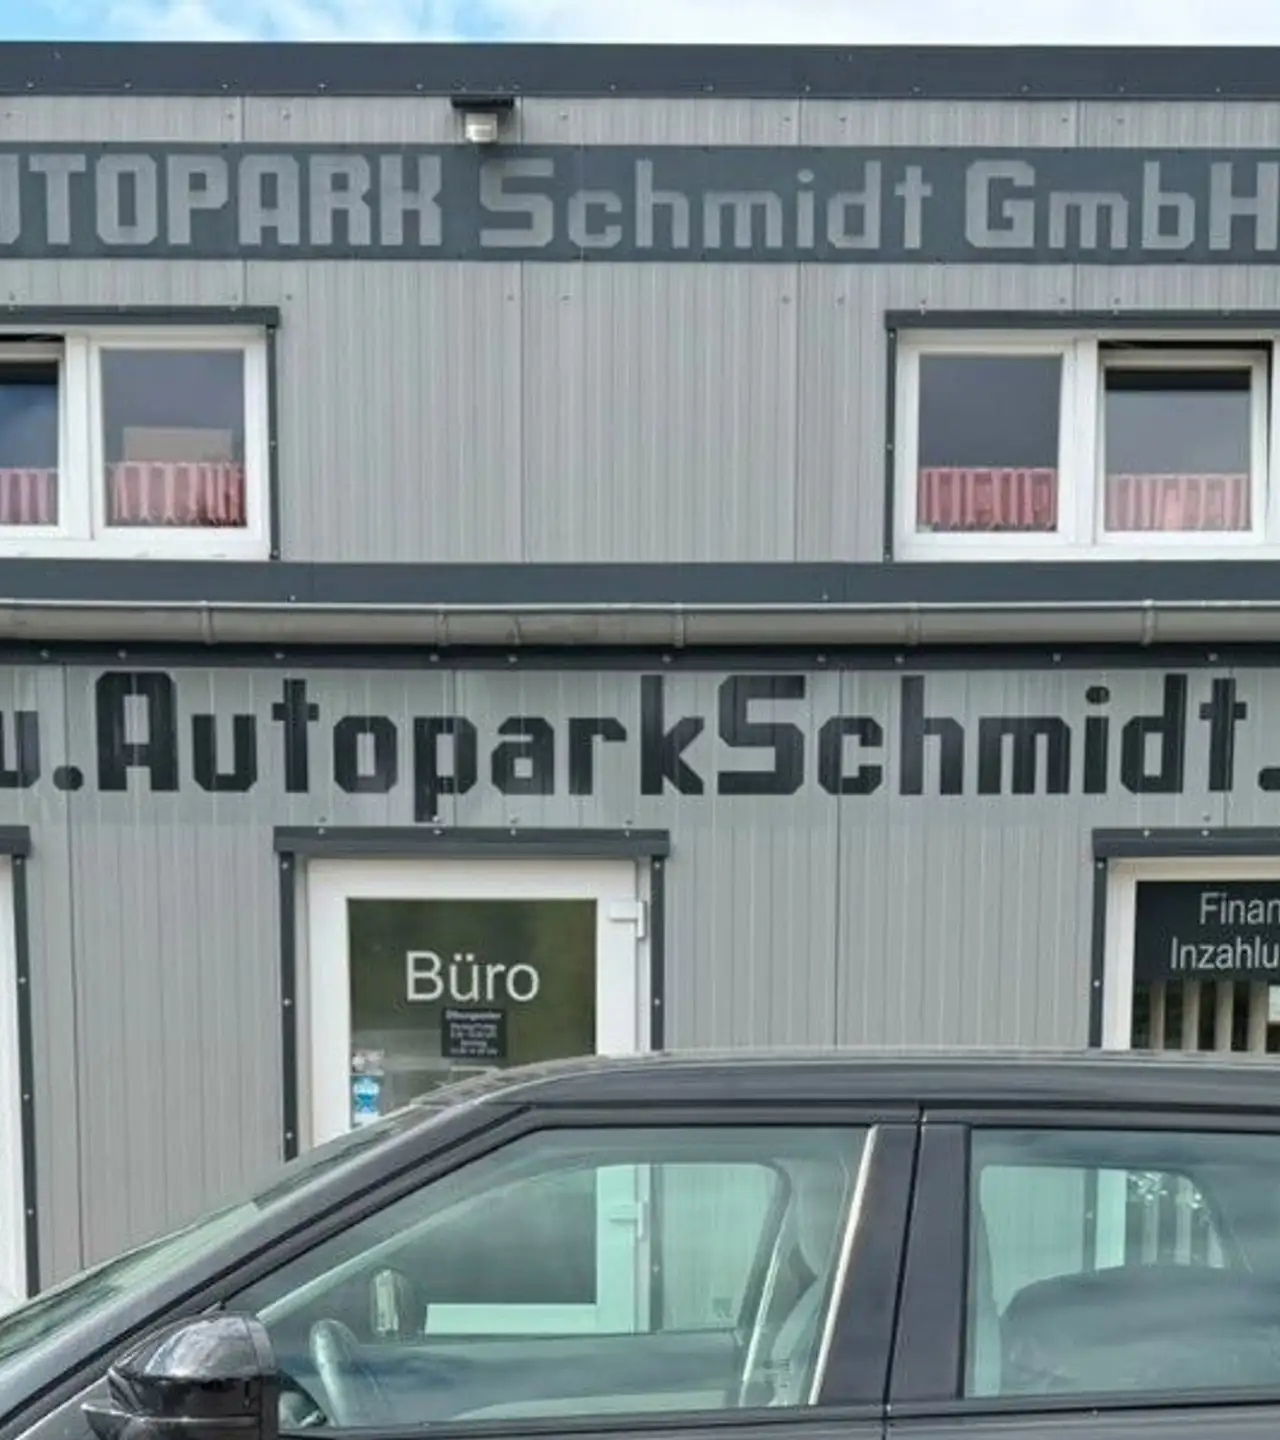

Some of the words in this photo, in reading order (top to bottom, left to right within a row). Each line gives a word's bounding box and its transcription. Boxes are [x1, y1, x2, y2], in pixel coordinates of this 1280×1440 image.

[480, 159, 933, 251] Schmidt
[965, 160, 1280, 252] GmbH
[405, 950, 540, 1002] Büro
